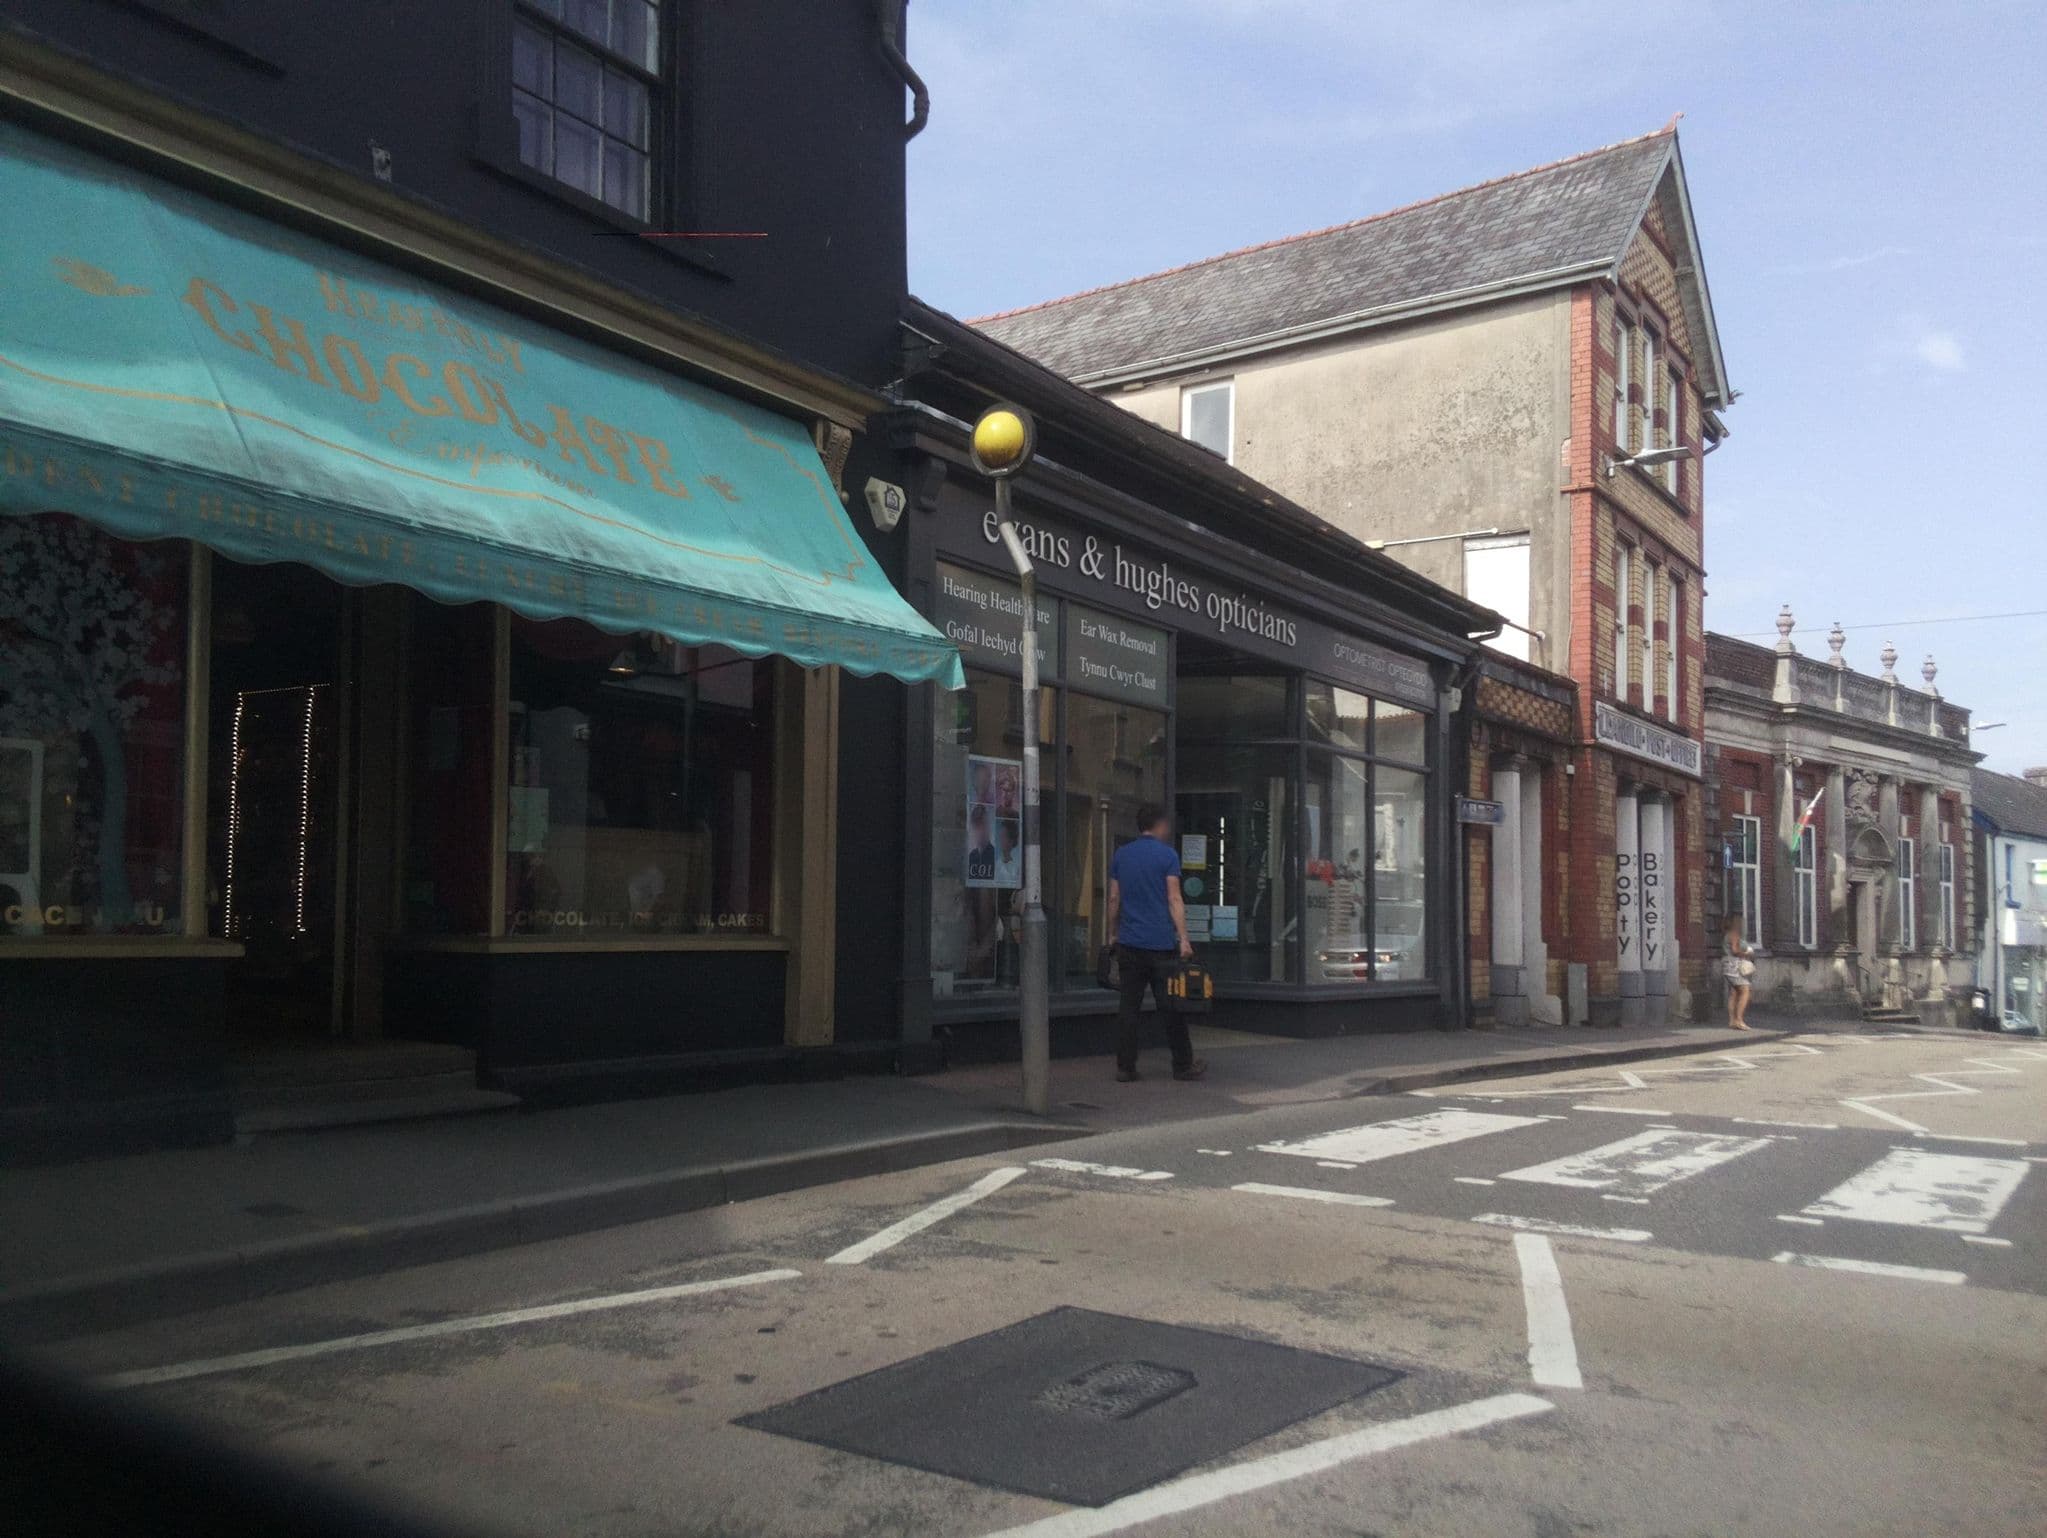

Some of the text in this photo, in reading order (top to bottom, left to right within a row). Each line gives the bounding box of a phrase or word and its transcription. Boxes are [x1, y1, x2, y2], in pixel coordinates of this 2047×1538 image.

[185, 277, 692, 500] CHOCOLATE
[943, 576, 987, 609] Hearing
[1080, 536, 1105, 582] &
[1115, 546, 1200, 613] hughes
[1207, 592, 1297, 650] opticians
[946, 620, 978, 644] Gofal
[981, 629, 1017, 657] Iechyd
[1081, 619, 1156, 656] Ear Wax Removal
[1080, 656, 1156, 691] Tynnu Cwyr Clust
[718, 911, 767, 927] CAKES
[1617, 853, 1630, 955] Popty
[1644, 852, 1658, 961] Bakery
